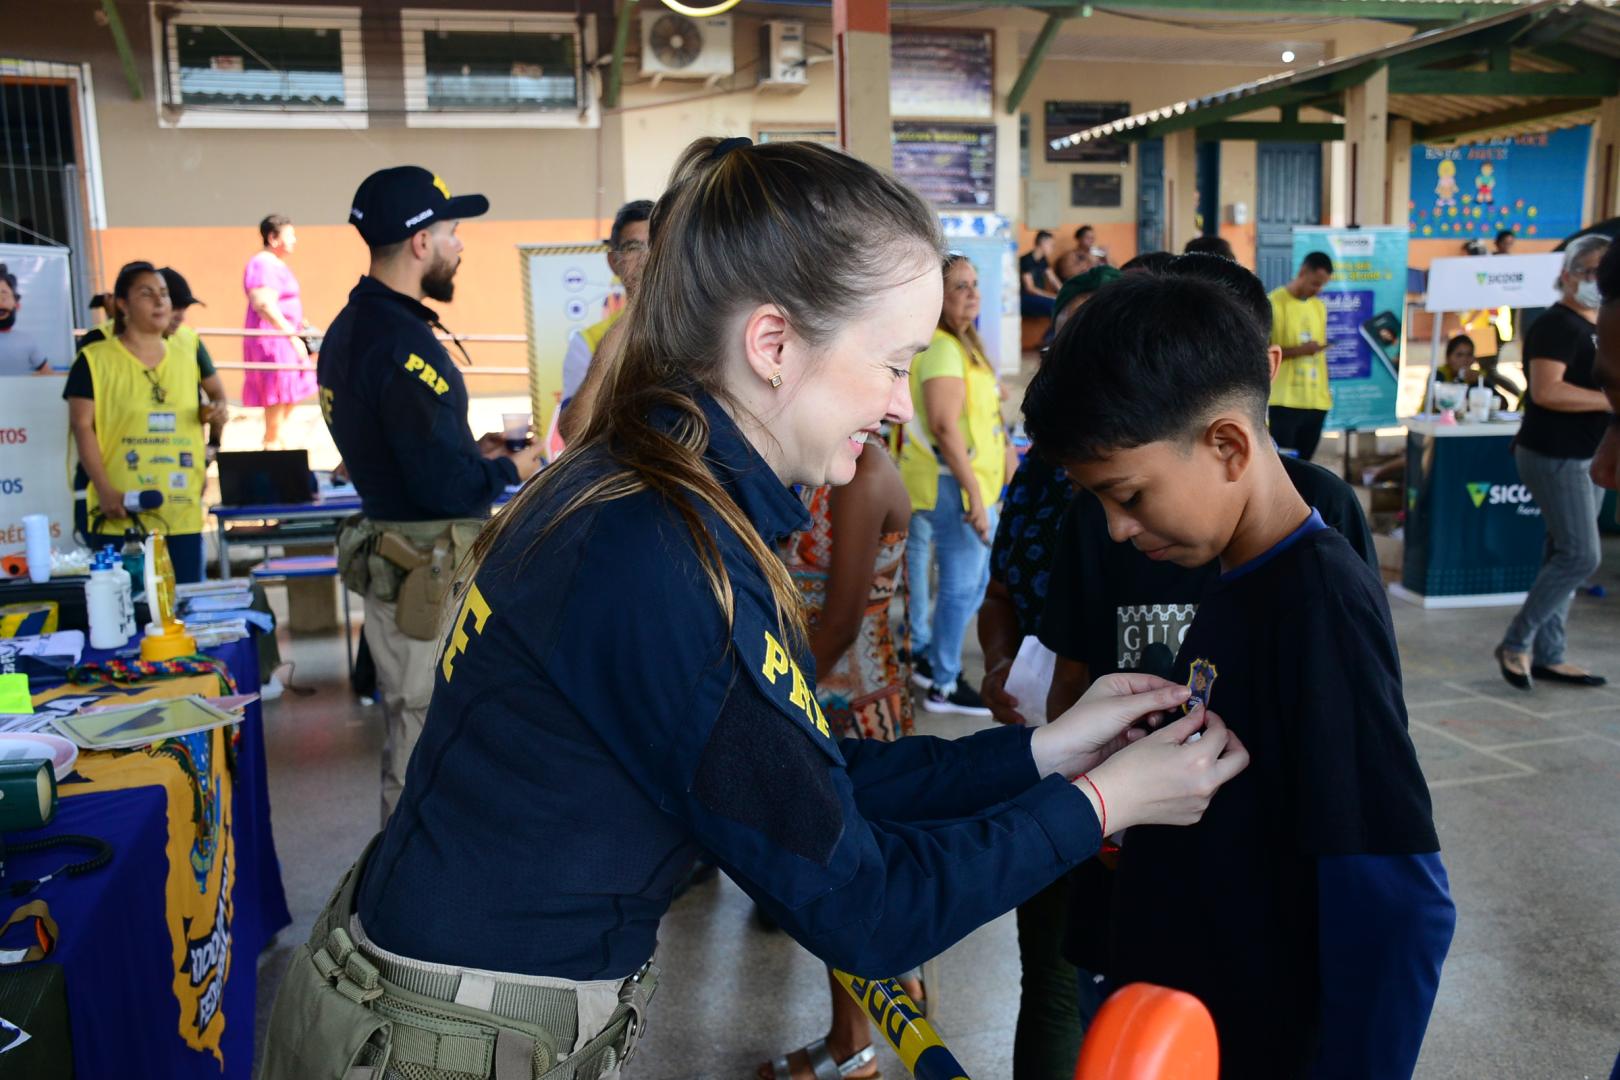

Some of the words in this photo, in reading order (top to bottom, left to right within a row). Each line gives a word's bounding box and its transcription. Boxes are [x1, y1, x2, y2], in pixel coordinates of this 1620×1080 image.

[404, 353, 449, 395] PRF
[0, 478, 23, 495] OS
[762, 630, 830, 738] PRF
